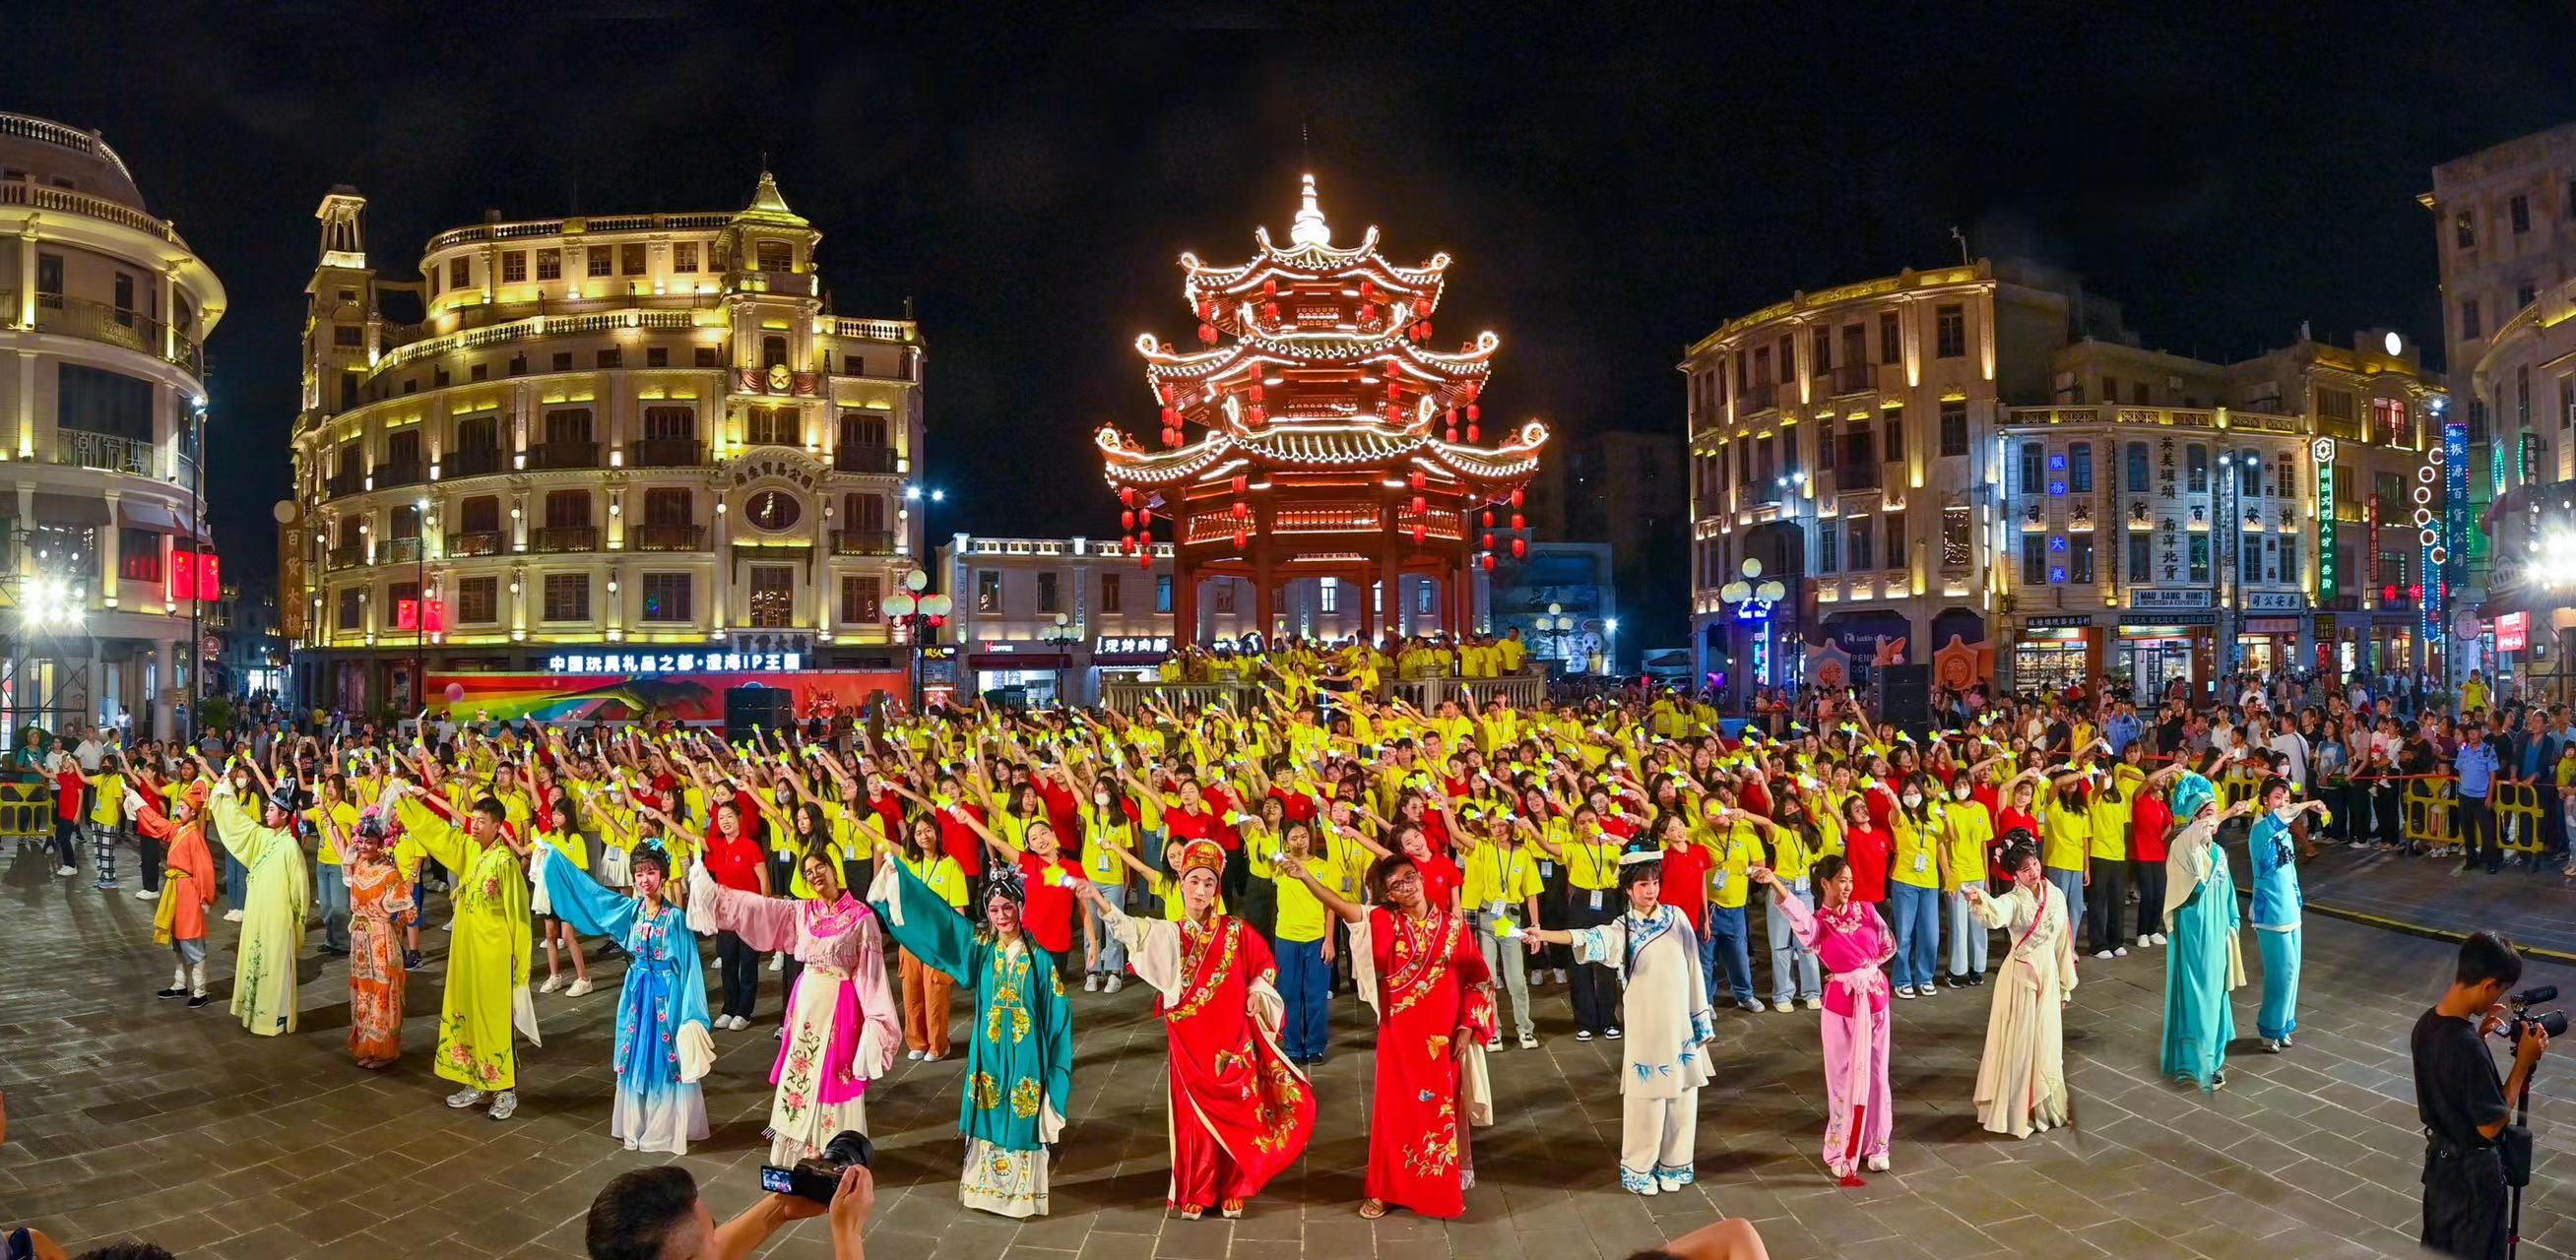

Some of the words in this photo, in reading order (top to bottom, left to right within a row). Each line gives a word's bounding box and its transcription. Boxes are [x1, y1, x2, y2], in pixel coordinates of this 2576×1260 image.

[2450, 442, 2465, 567] 振源百貨公司
[2161, 517, 2178, 581] 南洋北貨
[2140, 591, 2157, 600] MAU
